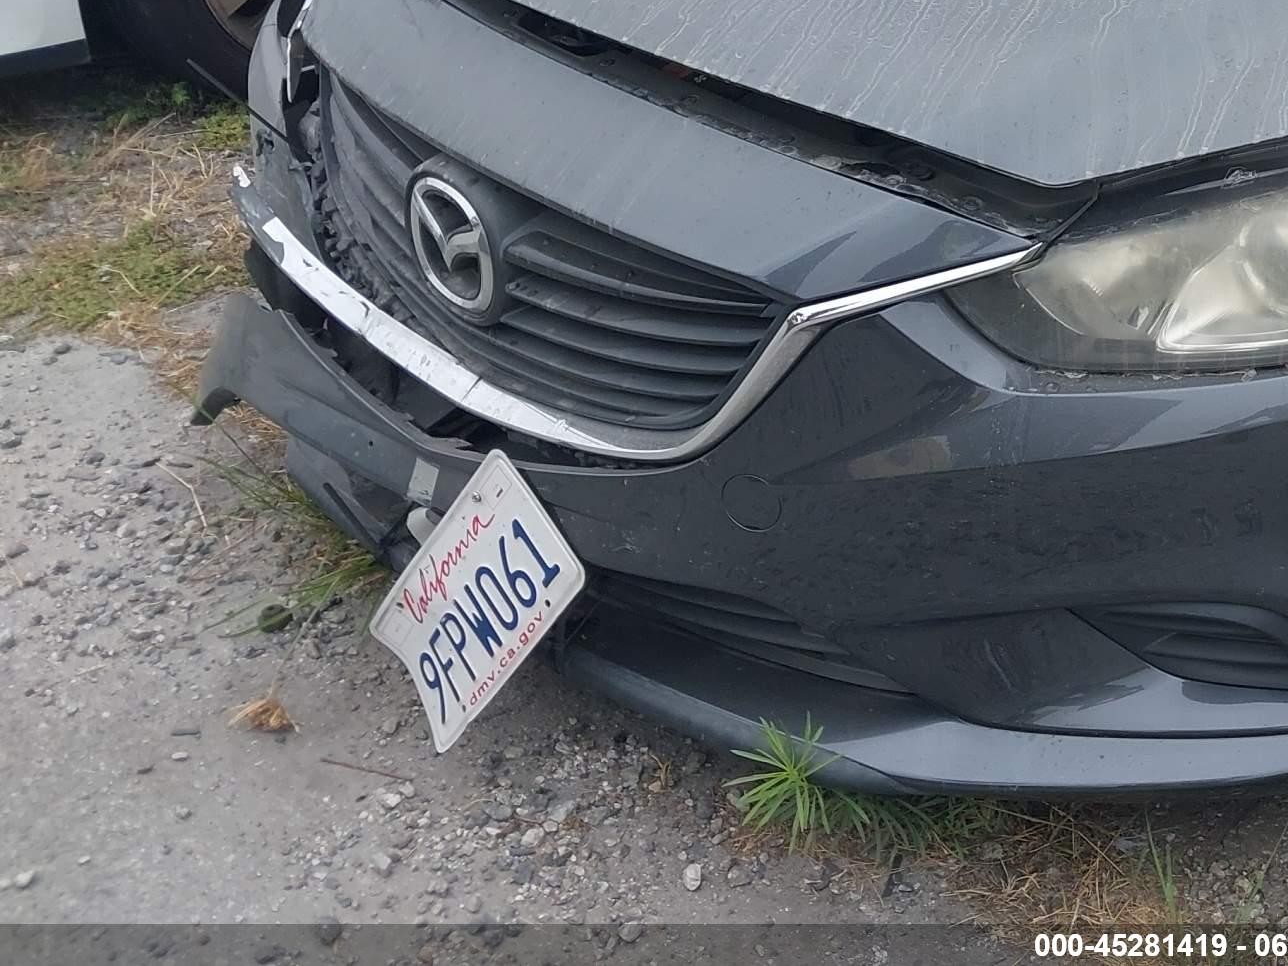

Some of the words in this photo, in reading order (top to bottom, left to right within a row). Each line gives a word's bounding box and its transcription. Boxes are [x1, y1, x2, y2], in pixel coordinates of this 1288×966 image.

[403, 513, 496, 624] California
[419, 519, 561, 725] 9FPW061
[468, 611, 544, 706] dmv.ca.gov
